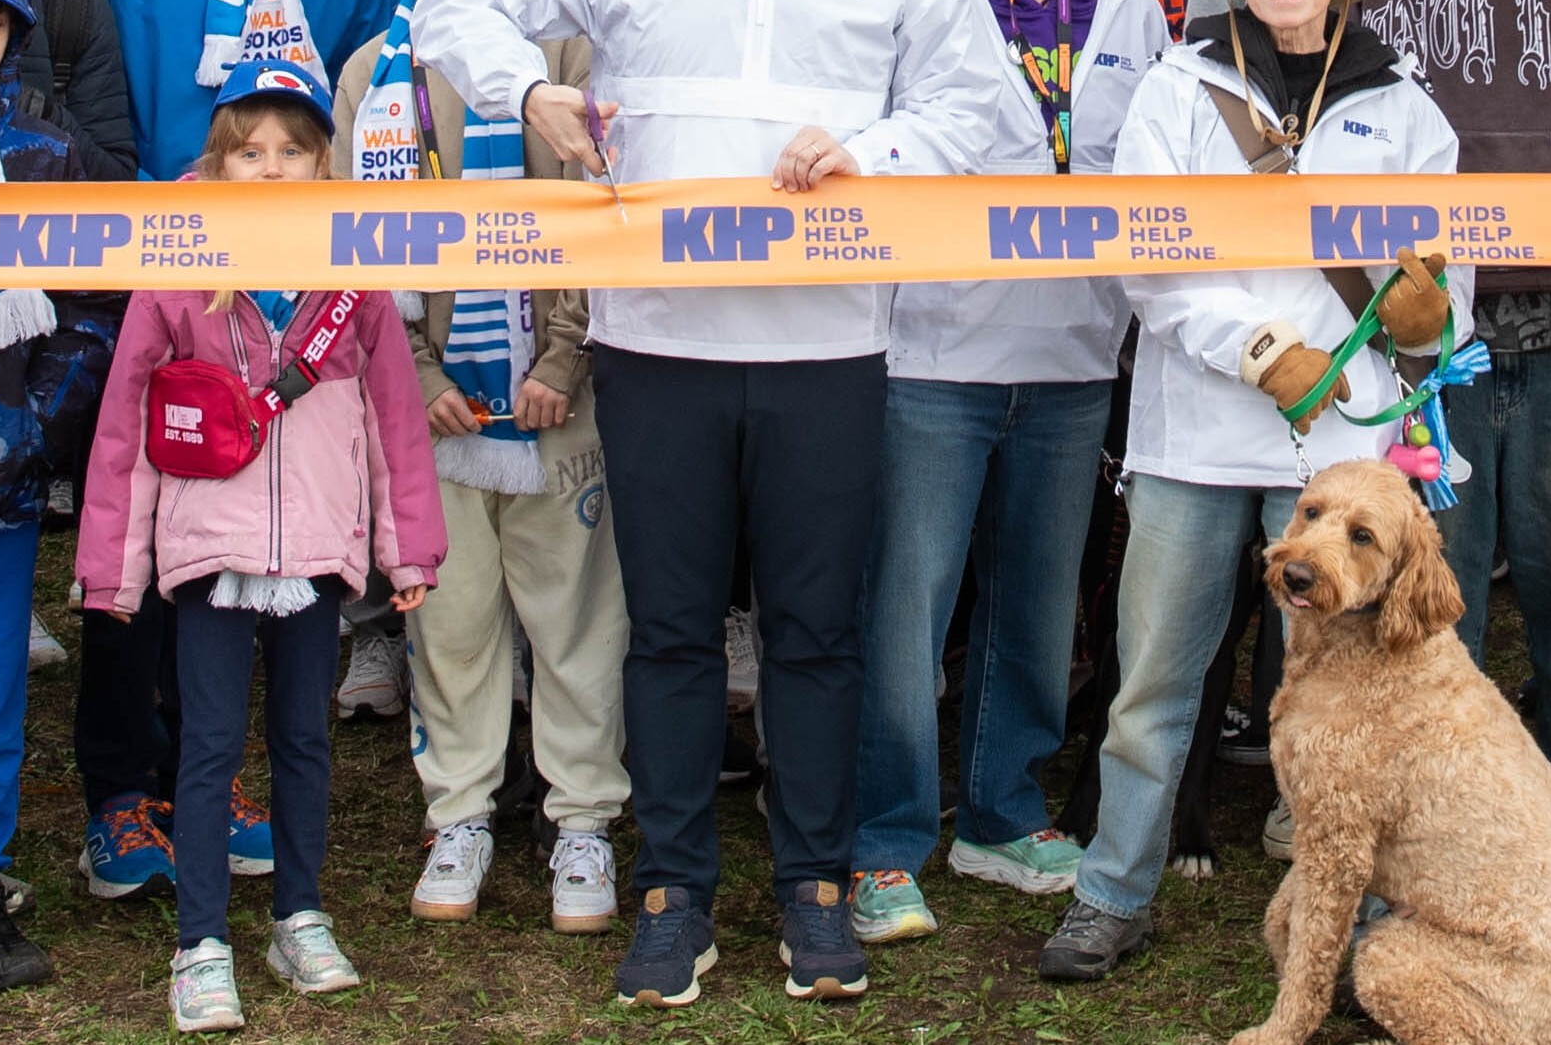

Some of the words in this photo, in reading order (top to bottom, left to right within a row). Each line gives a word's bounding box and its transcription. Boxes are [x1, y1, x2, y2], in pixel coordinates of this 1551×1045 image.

[1343, 119, 1373, 138] KHP
[361, 150, 388, 169] SO
[142, 215, 204, 230] KIDS
[330, 212, 466, 267] KHP
[475, 212, 537, 228] KIDS
[475, 231, 542, 245] HELP
[661, 207, 795, 263] KHP
[804, 208, 865, 223] KIDS
[805, 227, 870, 242] HELP
[988, 206, 1119, 260] KHP
[1129, 208, 1188, 222] KIDS
[1130, 227, 1194, 242] HELP
[1311, 205, 1440, 260] KHP
[1448, 207, 1507, 221] KIDS
[1450, 227, 1512, 242] HELP
[142, 234, 208, 249] HELP
[141, 253, 231, 267] PHONE
[475, 250, 564, 264] PHONE
[806, 246, 893, 261] PHONE
[1131, 246, 1217, 260] PHONE
[1451, 246, 1536, 259] PHONE
[556, 447, 605, 491] NIK
